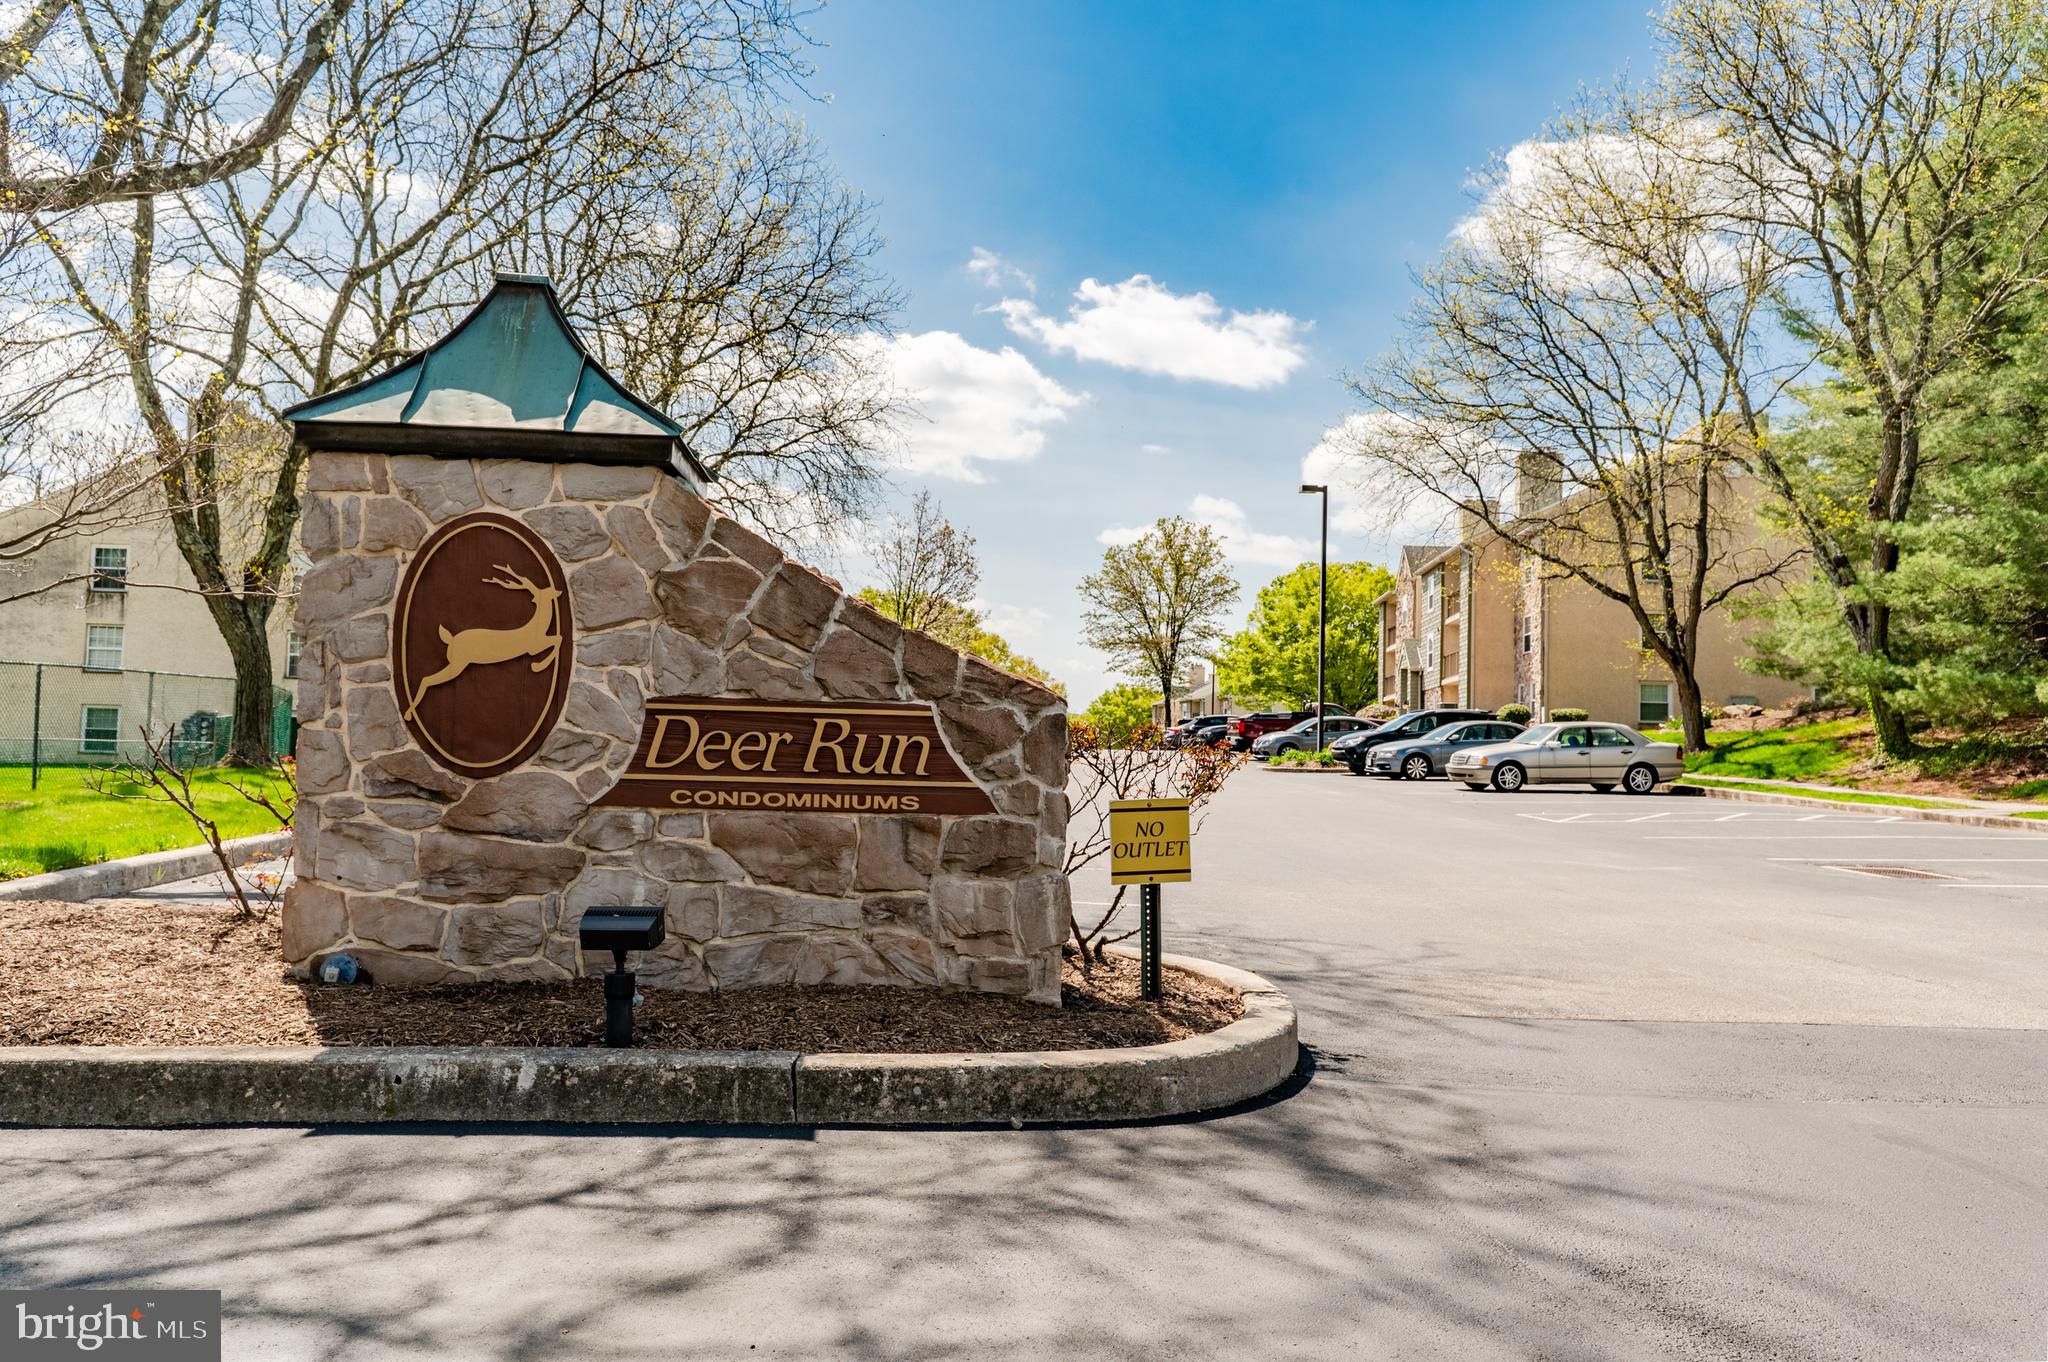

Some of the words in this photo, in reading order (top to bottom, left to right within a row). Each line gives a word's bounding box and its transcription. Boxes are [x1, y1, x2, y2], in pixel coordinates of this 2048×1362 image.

[644, 714, 792, 772] Deer
[803, 717, 931, 776] Run
[670, 789, 920, 811] CONDOMINIUMS
[1135, 821, 1164, 837] NO
[1113, 840, 1188, 859] OUTLET
